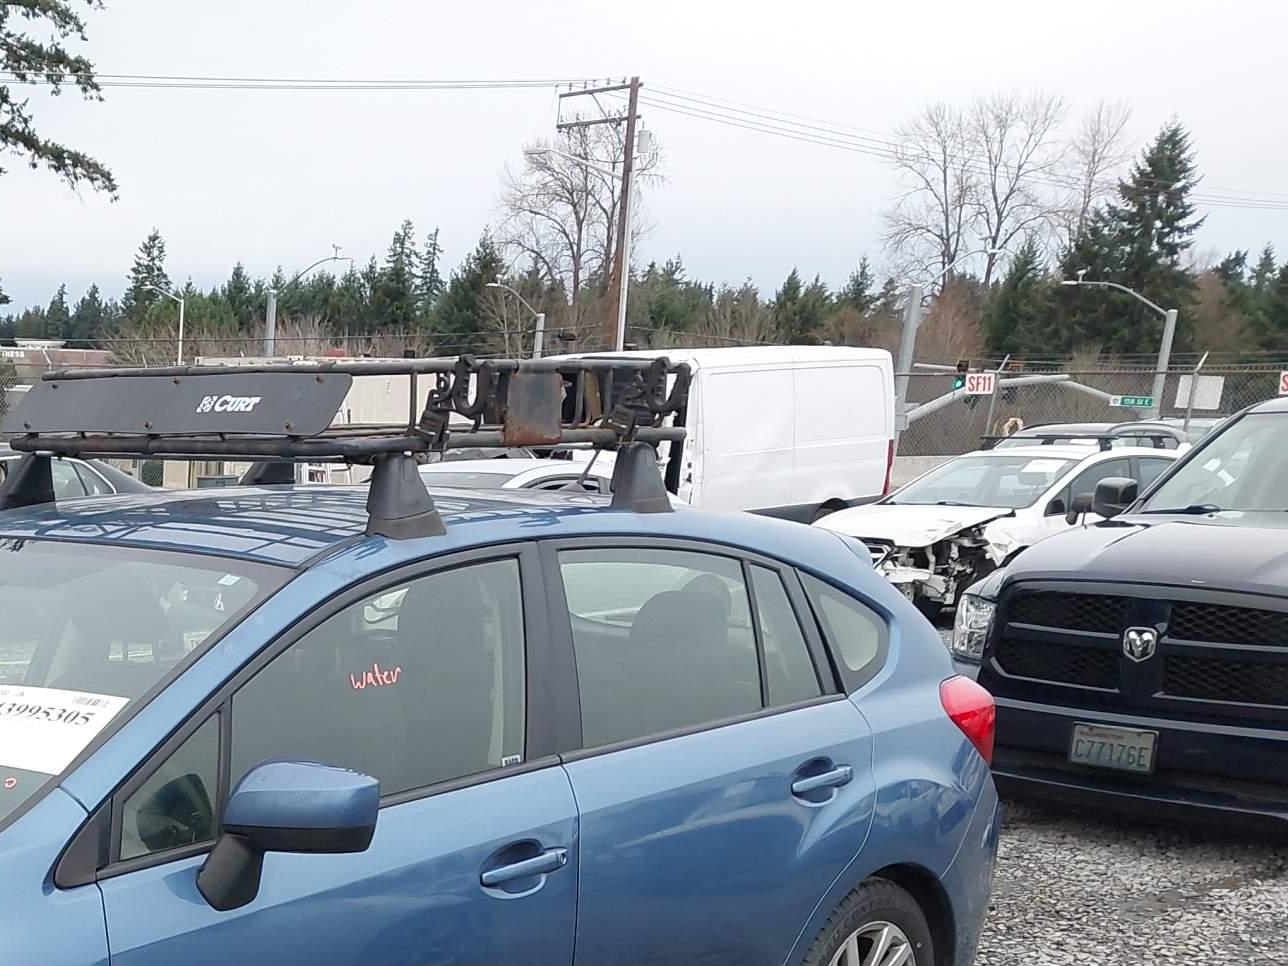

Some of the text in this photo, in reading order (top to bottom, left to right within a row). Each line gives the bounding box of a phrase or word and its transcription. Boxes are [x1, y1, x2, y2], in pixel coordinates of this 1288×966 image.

[967, 375, 992, 392] SF11
[214, 394, 263, 413] CURT
[350, 663, 402, 689] water
[1074, 738, 1150, 767] C77176E
